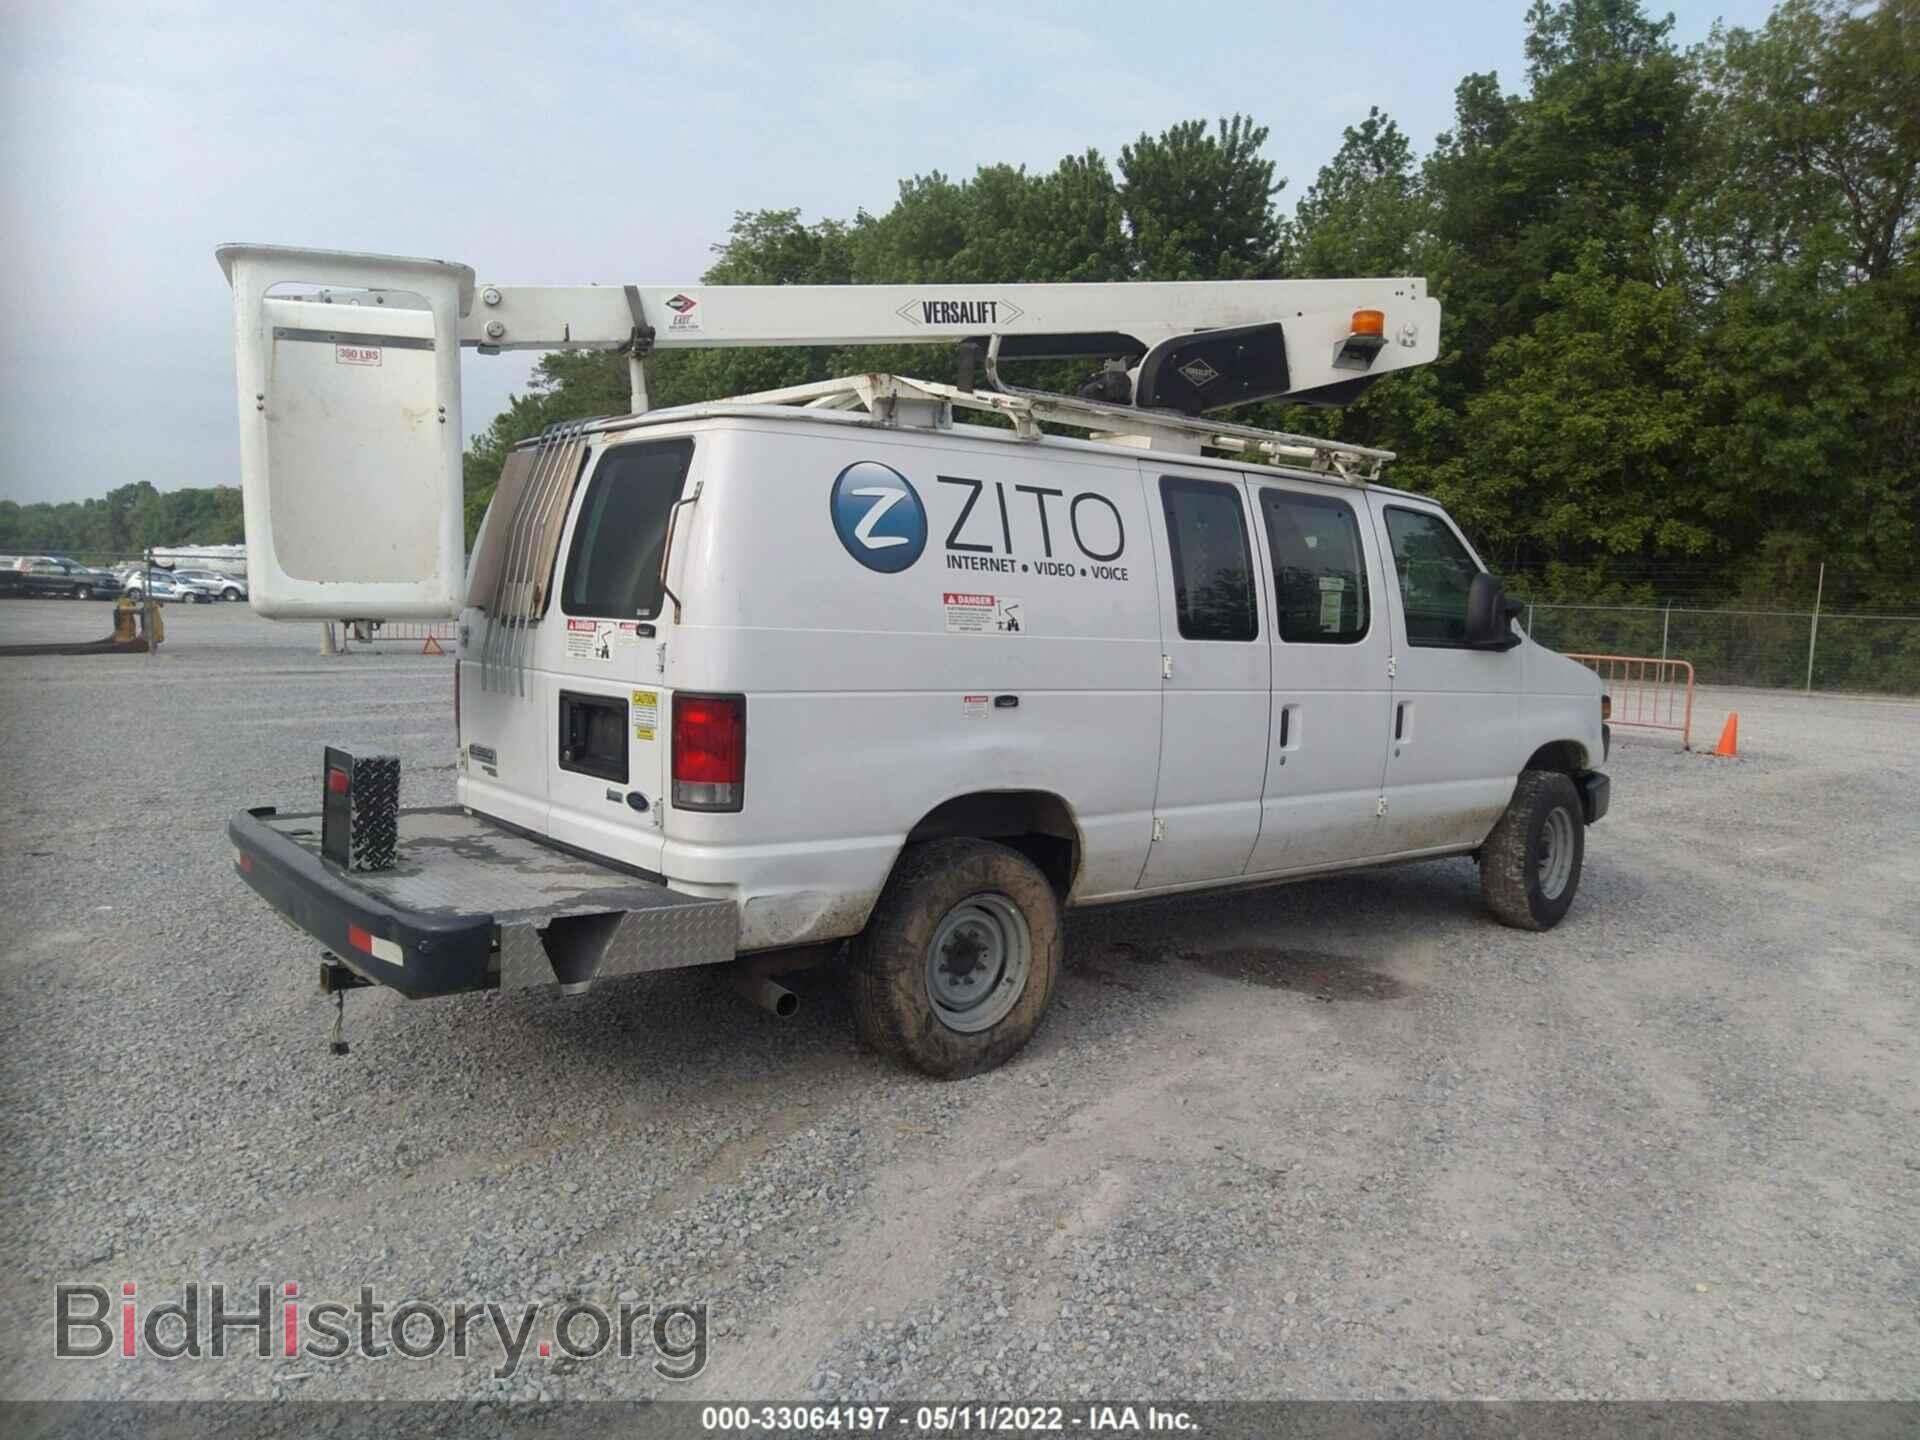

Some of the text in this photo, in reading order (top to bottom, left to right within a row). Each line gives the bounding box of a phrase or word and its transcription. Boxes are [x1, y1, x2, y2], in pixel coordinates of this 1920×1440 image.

[922, 301, 998, 324] VERSALIFT
[360, 350, 378, 360] LBS
[936, 475, 1125, 562] ZITO
[946, 554, 1129, 582] INTERNET VIDEO VOICE
[957, 595, 992, 605] DANGER
